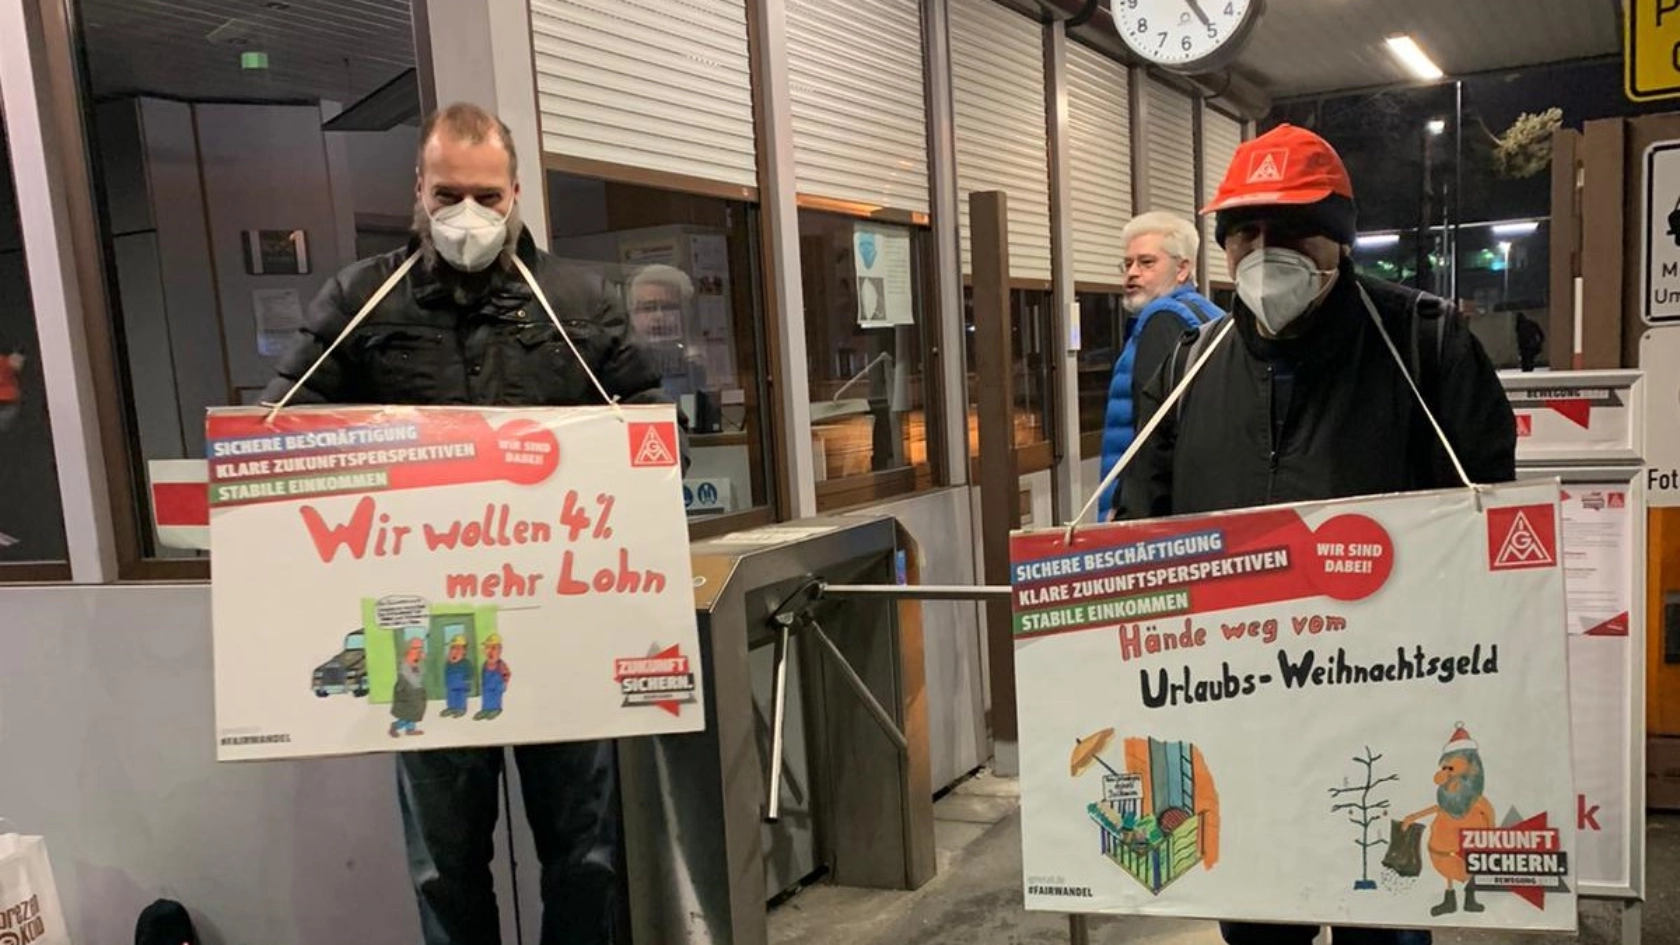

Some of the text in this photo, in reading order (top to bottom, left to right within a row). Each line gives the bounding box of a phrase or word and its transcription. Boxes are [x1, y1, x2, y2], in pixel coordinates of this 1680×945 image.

[1223, 2, 1234, 16] 4
[1137, 18, 1148, 33] 8
[1207, 23, 1218, 38] 5
[1157, 32, 1168, 48] 7
[1181, 36, 1192, 51] 6
[213, 424, 418, 457] SICHERE BESCHÄFTIGUNG
[498, 439, 521, 451] WIR
[216, 443, 475, 478] KLARE ZUKUNFTSPERSPEKTIVEN
[219, 472, 387, 501] STABILE EINKOMMEN
[1648, 468, 1678, 490] Fot
[299, 489, 616, 563] Wir wollen 4%
[1016, 532, 1222, 582] SICHERE BESCHÄFTIGUNG
[1316, 543, 1383, 557] WIR SIND
[446, 547, 667, 598] mehr Lohn
[1019, 549, 1289, 606] KLARE ZUKUNFTSPERSPEKTIVEN
[1324, 560, 1373, 574] DABEI!
[1021, 592, 1188, 631] STABILE EINKOMMEN
[1119, 614, 1347, 661] Hände weg vom
[616, 657, 688, 675] ZUKUNFT
[1462, 829, 1556, 850] ZUKUNFT
[1467, 853, 1566, 873] SICHERN.
